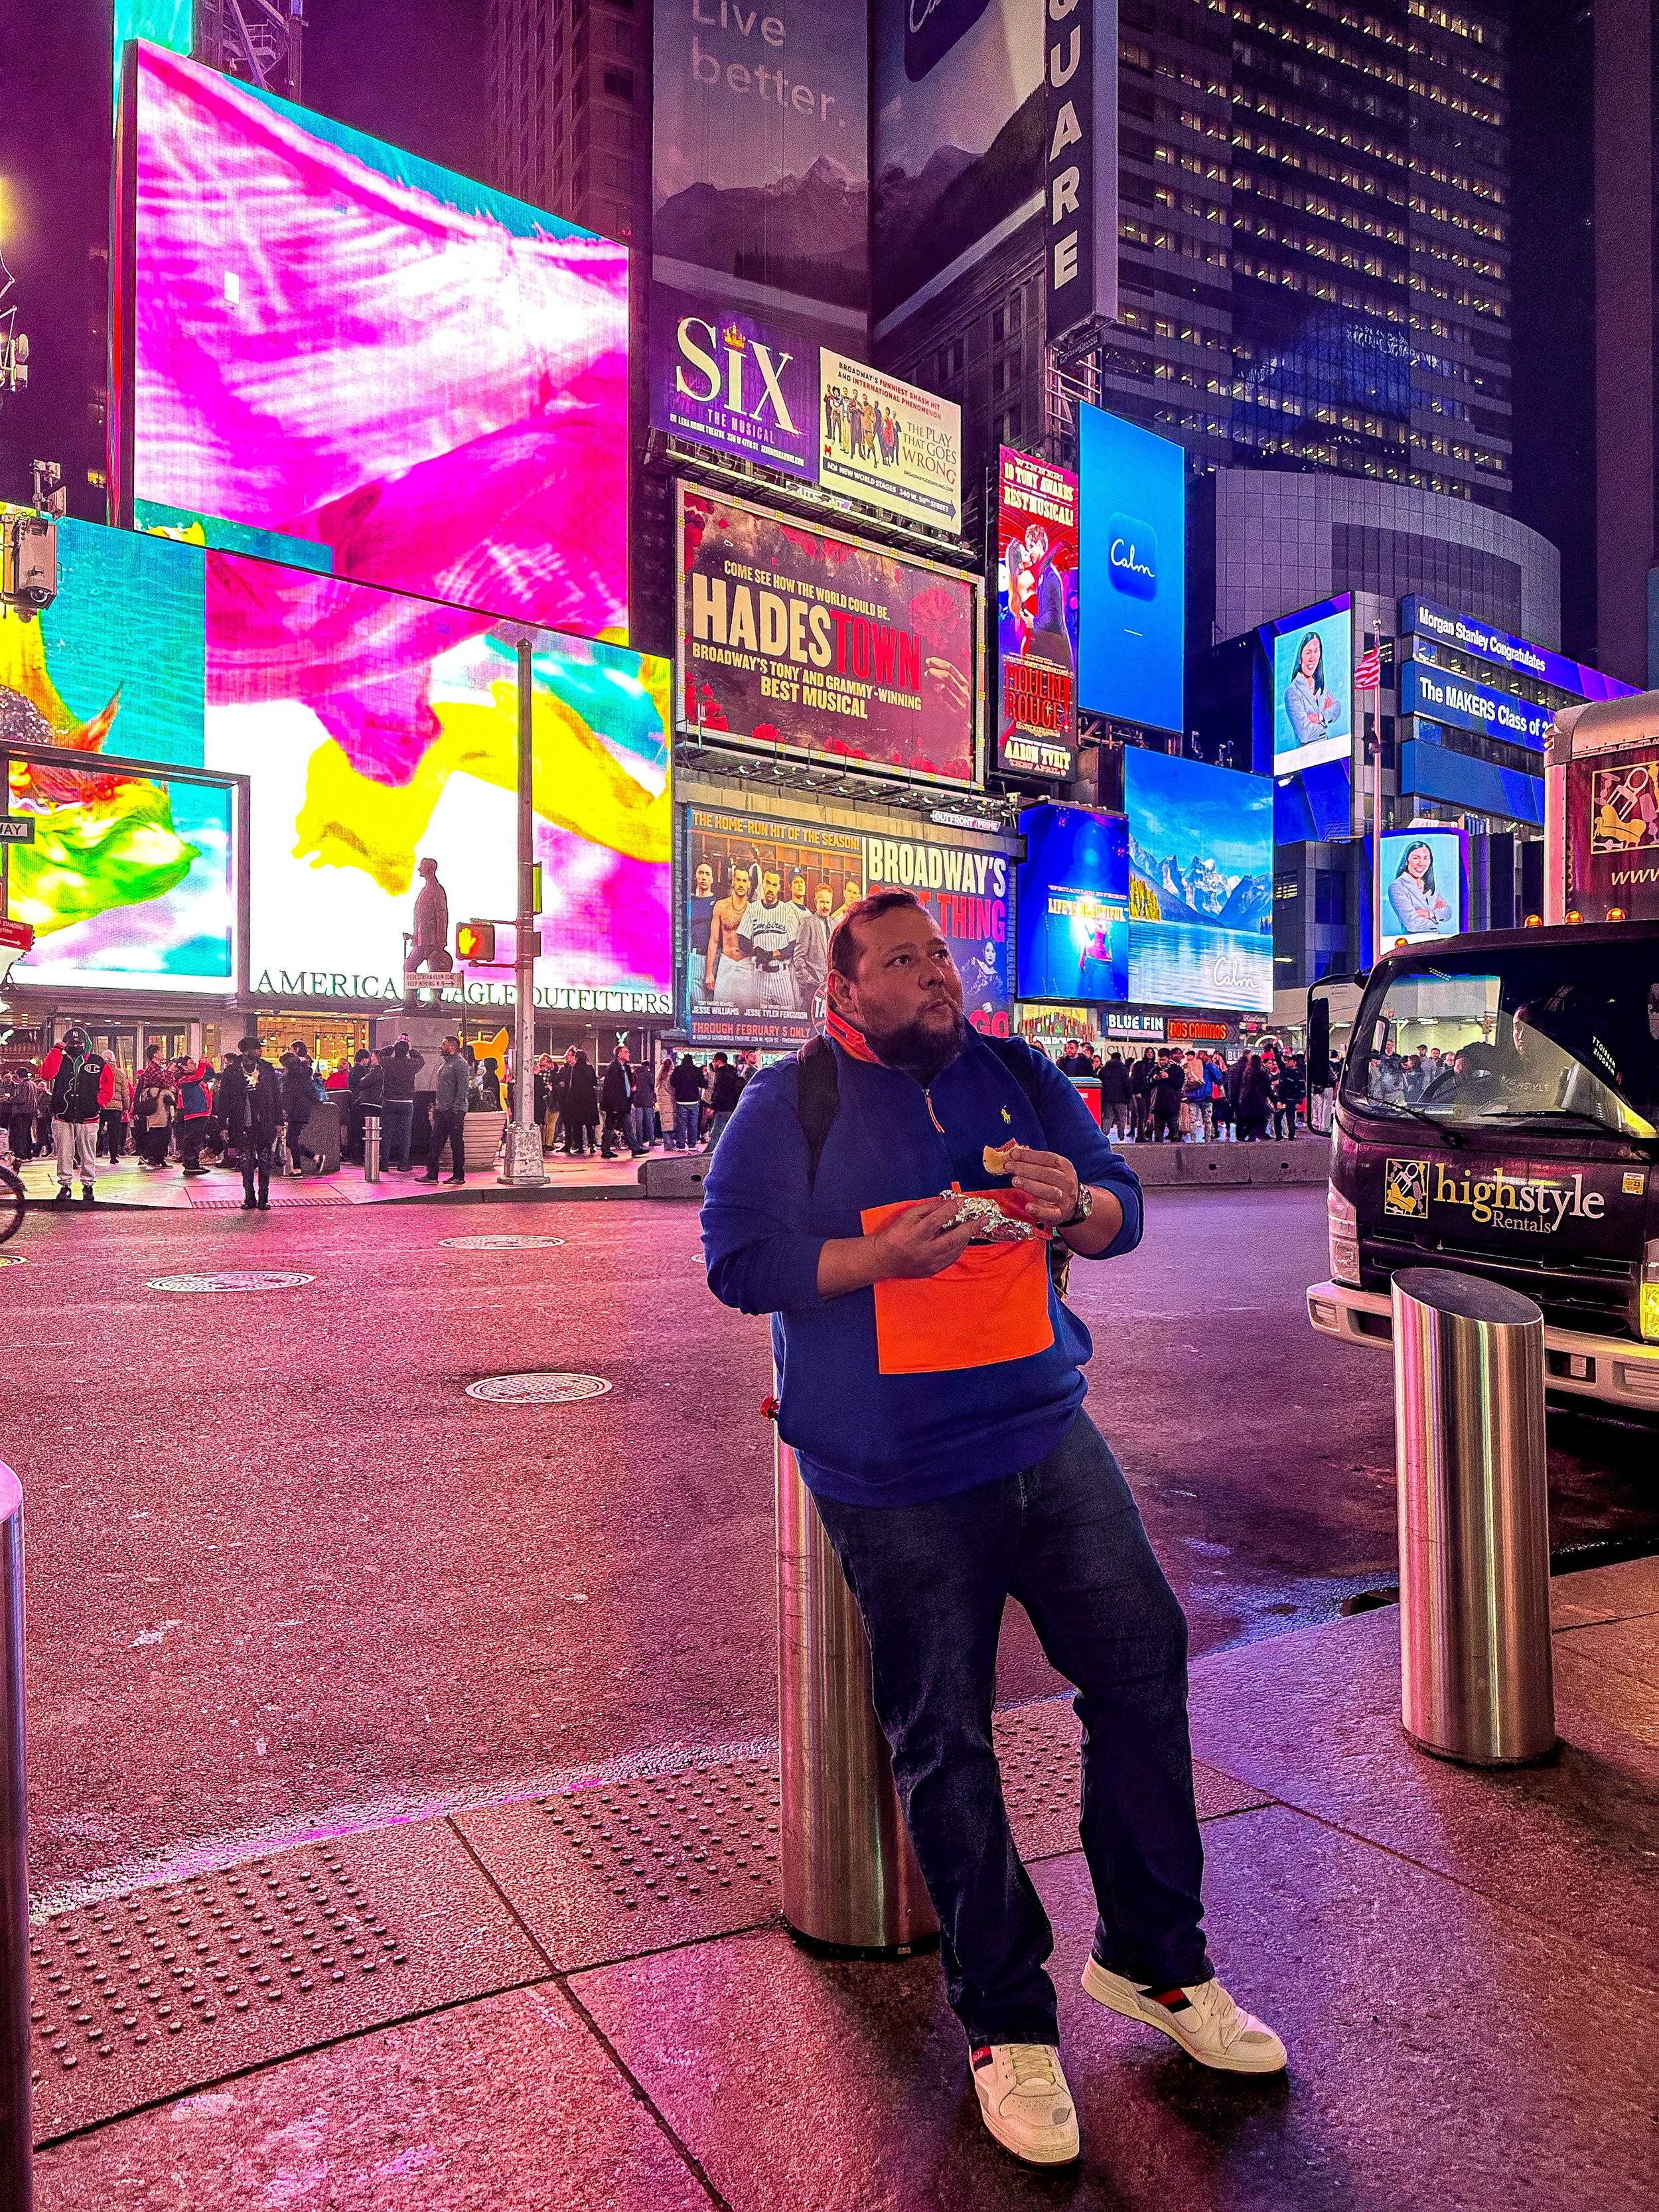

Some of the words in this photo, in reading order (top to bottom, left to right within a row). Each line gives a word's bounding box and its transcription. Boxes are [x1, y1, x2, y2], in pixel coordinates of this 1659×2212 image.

[693, 0, 786, 46] Live
[692, 36, 845, 126] better.
[837, 371, 851, 382] AND
[853, 376, 900, 403] INTERNATIONAL
[901, 398, 942, 420] PHENOMENON
[839, 362, 878, 384] BROADWAY'S
[879, 380, 908, 396] FUNNIEST
[910, 392, 929, 406] SMASH
[930, 401, 940, 411] HIT
[707, 409, 727, 427] THE
[731, 417, 774, 444] MUSICAL
[906, 421, 924, 437] THE
[926, 426, 952, 448] PLAY
[902, 433, 924, 450] THAT
[926, 443, 956, 465] GOES
[902, 446, 956, 484] WRONG
[839, 466, 854, 477] NEW
[854, 471, 875, 485] WORLD
[875, 479, 896, 493] STAGES
[899, 488, 910, 498] 340
[930, 500, 949, 512] STREET
[1015, 466, 1039, 490] TONY
[1040, 476, 1074, 502] AWARDS
[1003, 486, 1029, 510] BEST
[1029, 494, 1073, 527] MUSICAL!
[1110, 538, 1155, 578] Calm
[724, 559, 753, 583] COME
[755, 567, 772, 586] SEE
[773, 571, 796, 591] HOW
[797, 577, 814, 597] THE
[816, 585, 847, 607] WORLD
[848, 595, 876, 617] COULD
[877, 605, 891, 621] BE.
[1419, 607, 1455, 636] Morgan
[1455, 621, 1488, 651] Stanley
[1490, 636, 1546, 672] Congratulates
[692, 642, 768, 674] BROADWAY'S
[802, 667, 824, 688] AND
[1004, 662, 1062, 701] MOULIN
[760, 676, 800, 702] BEST
[802, 687, 868, 719] MUSICAL
[1419, 676, 1443, 703] The
[1445, 685, 1496, 721] MAKERS
[1497, 705, 1527, 732] Class
[1529, 718, 1540, 737] of
[1004, 740, 1039, 763] AARON
[693, 812, 713, 827] THE
[715, 815, 768, 838] HOME-RUN
[770, 823, 786, 839] HIT
[788, 826, 800, 841] OF
[803, 830, 820, 844] THE
[822, 832, 860, 851] SEASON!
[869, 838, 1006, 897] BROADWAY'S
[936, 893, 1005, 942] THING
[257, 970, 399, 999] AMERICA
[1213, 956, 1258, 990] Calm
[692, 1022, 734, 1034] THROUGH
[736, 1024, 780, 1036] FEBRUARY
[790, 1027, 811, 1038] ONLY
[711, 1007, 739, 1015] WILLIAMS
[744, 1008, 762, 1017] JESSE
[780, 1011, 808, 1019] FERGUSON
[1108, 1013, 1139, 1029] BLUE
[1143, 1016, 1163, 1031] FIN
[1170, 1021, 1188, 1038] DOS
[1491, 1211, 1551, 1234] Rentals
